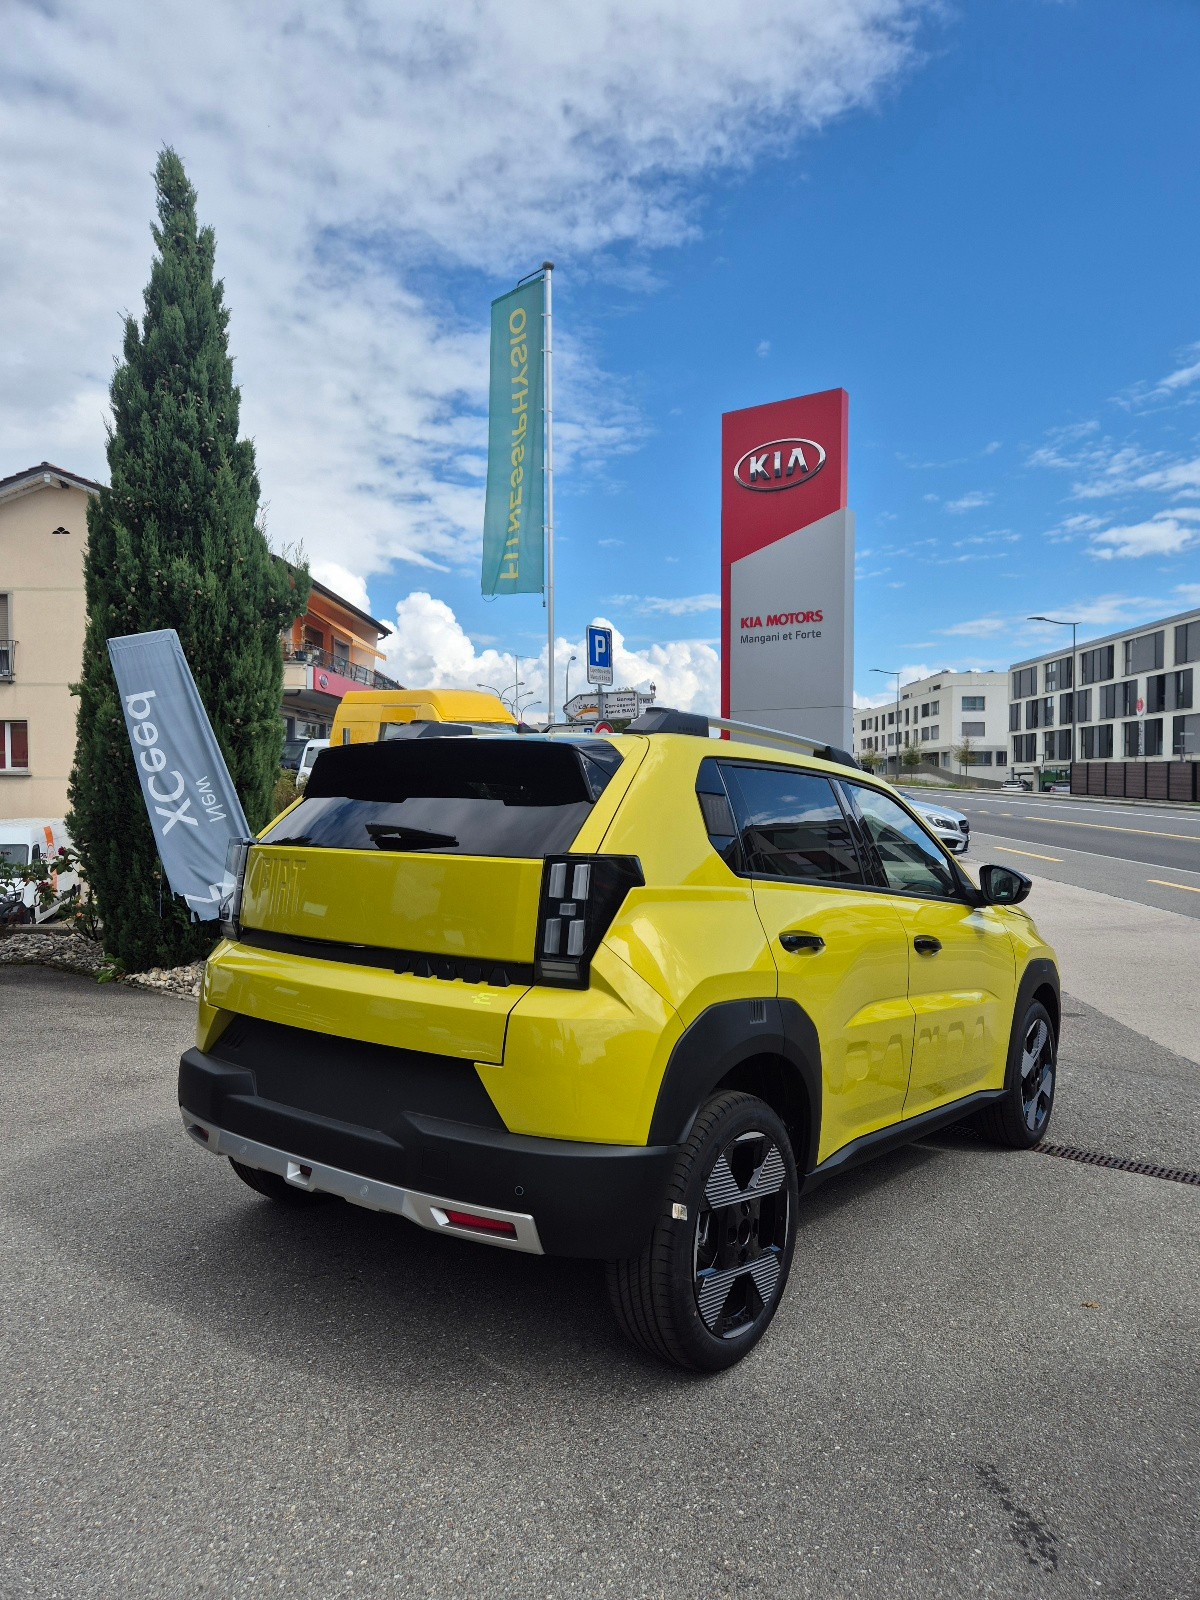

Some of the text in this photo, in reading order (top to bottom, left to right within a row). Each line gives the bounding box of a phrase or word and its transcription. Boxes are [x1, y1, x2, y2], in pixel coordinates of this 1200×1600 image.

[749, 447, 810, 482] KIA
[740, 609, 824, 629] KIA MOTORS
[594, 634, 606, 662] P
[740, 629, 822, 644] Mangani et Forte
[257, 857, 307, 915] FIAT
